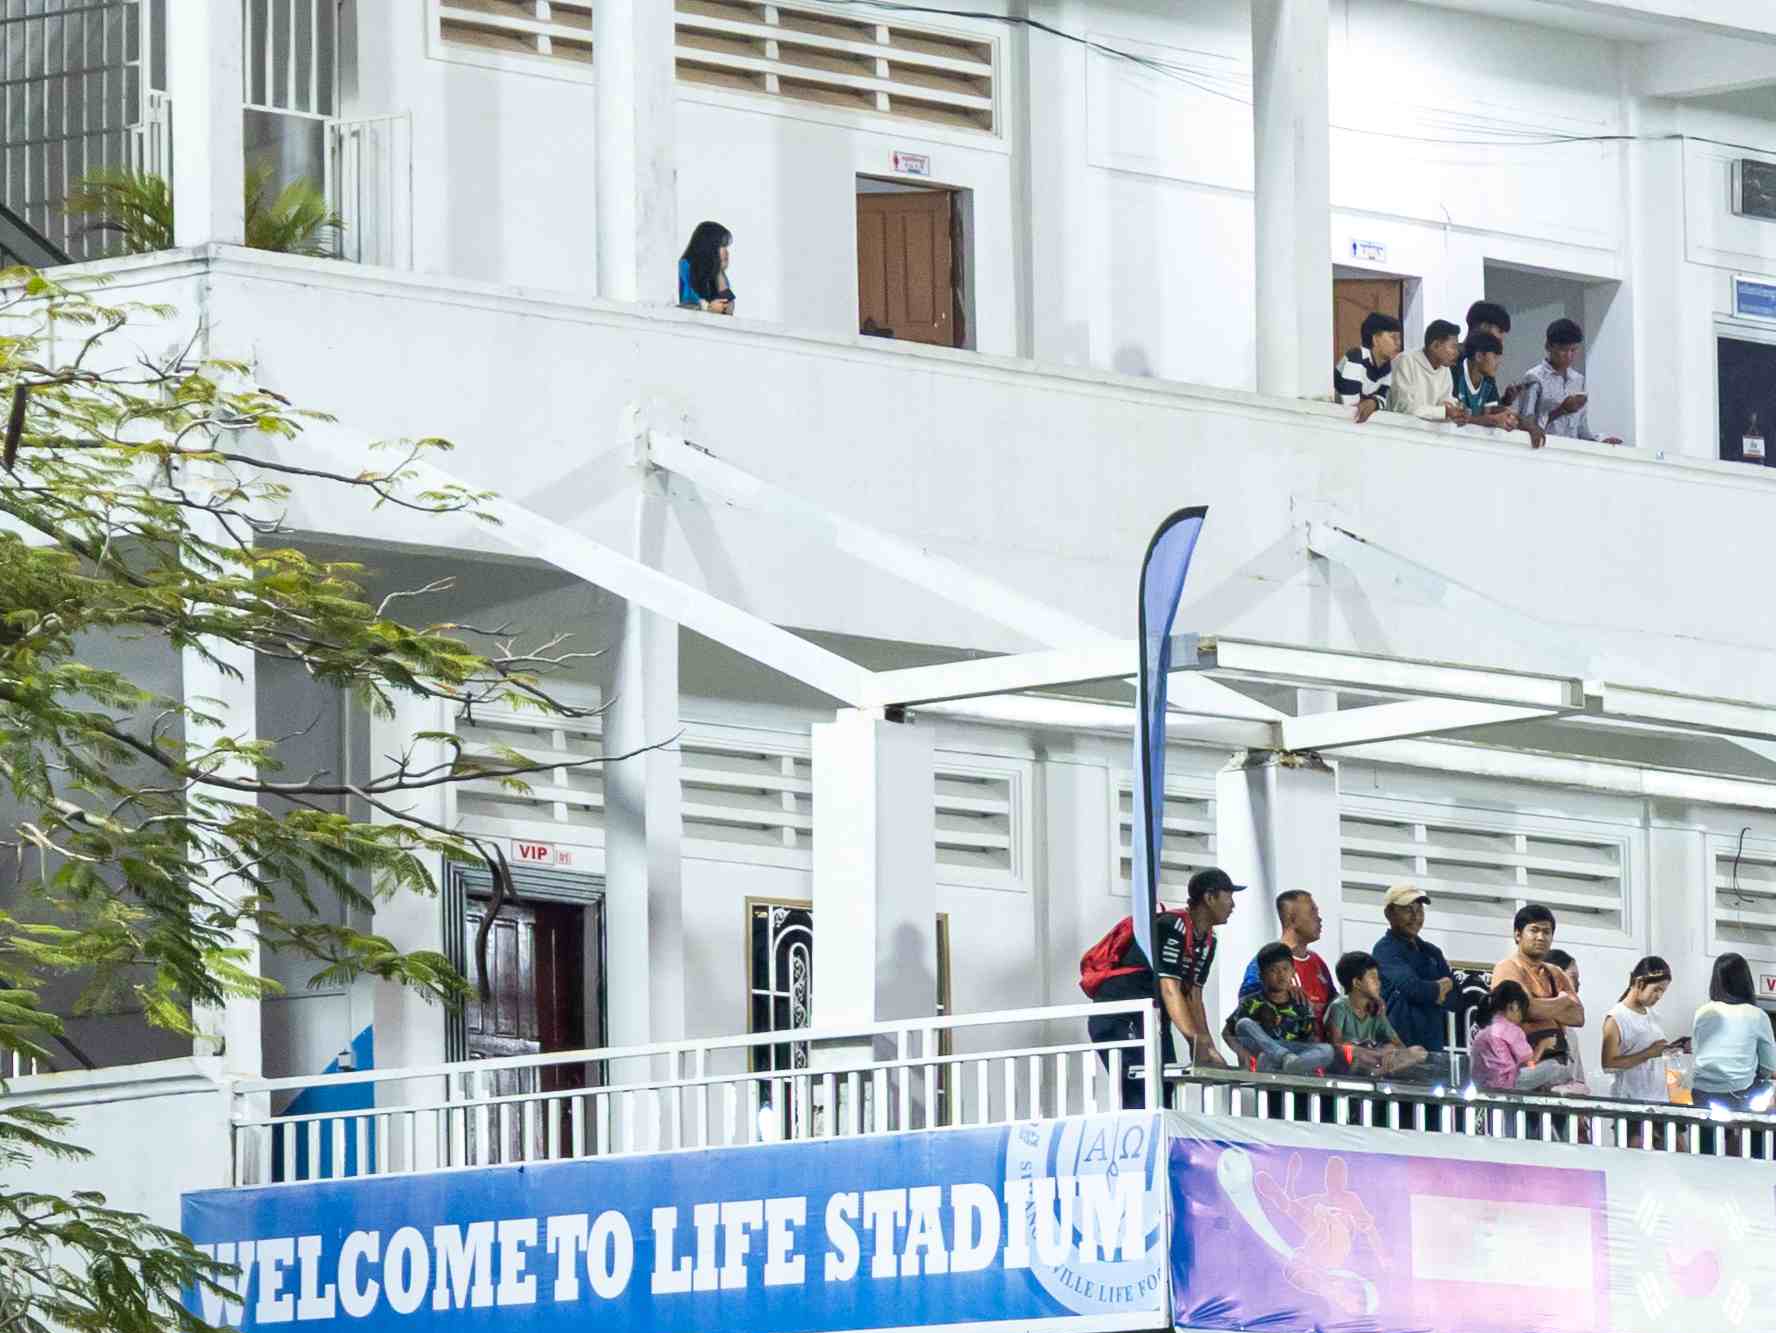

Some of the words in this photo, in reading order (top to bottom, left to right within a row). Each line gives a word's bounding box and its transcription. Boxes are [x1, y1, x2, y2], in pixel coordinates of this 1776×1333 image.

[520, 844, 547, 860] VIP
[196, 1218, 538, 1328] WELCOME
[546, 1209, 634, 1301] TO
[651, 1197, 807, 1296] LIFE
[825, 1171, 1146, 1281] STADIUM
